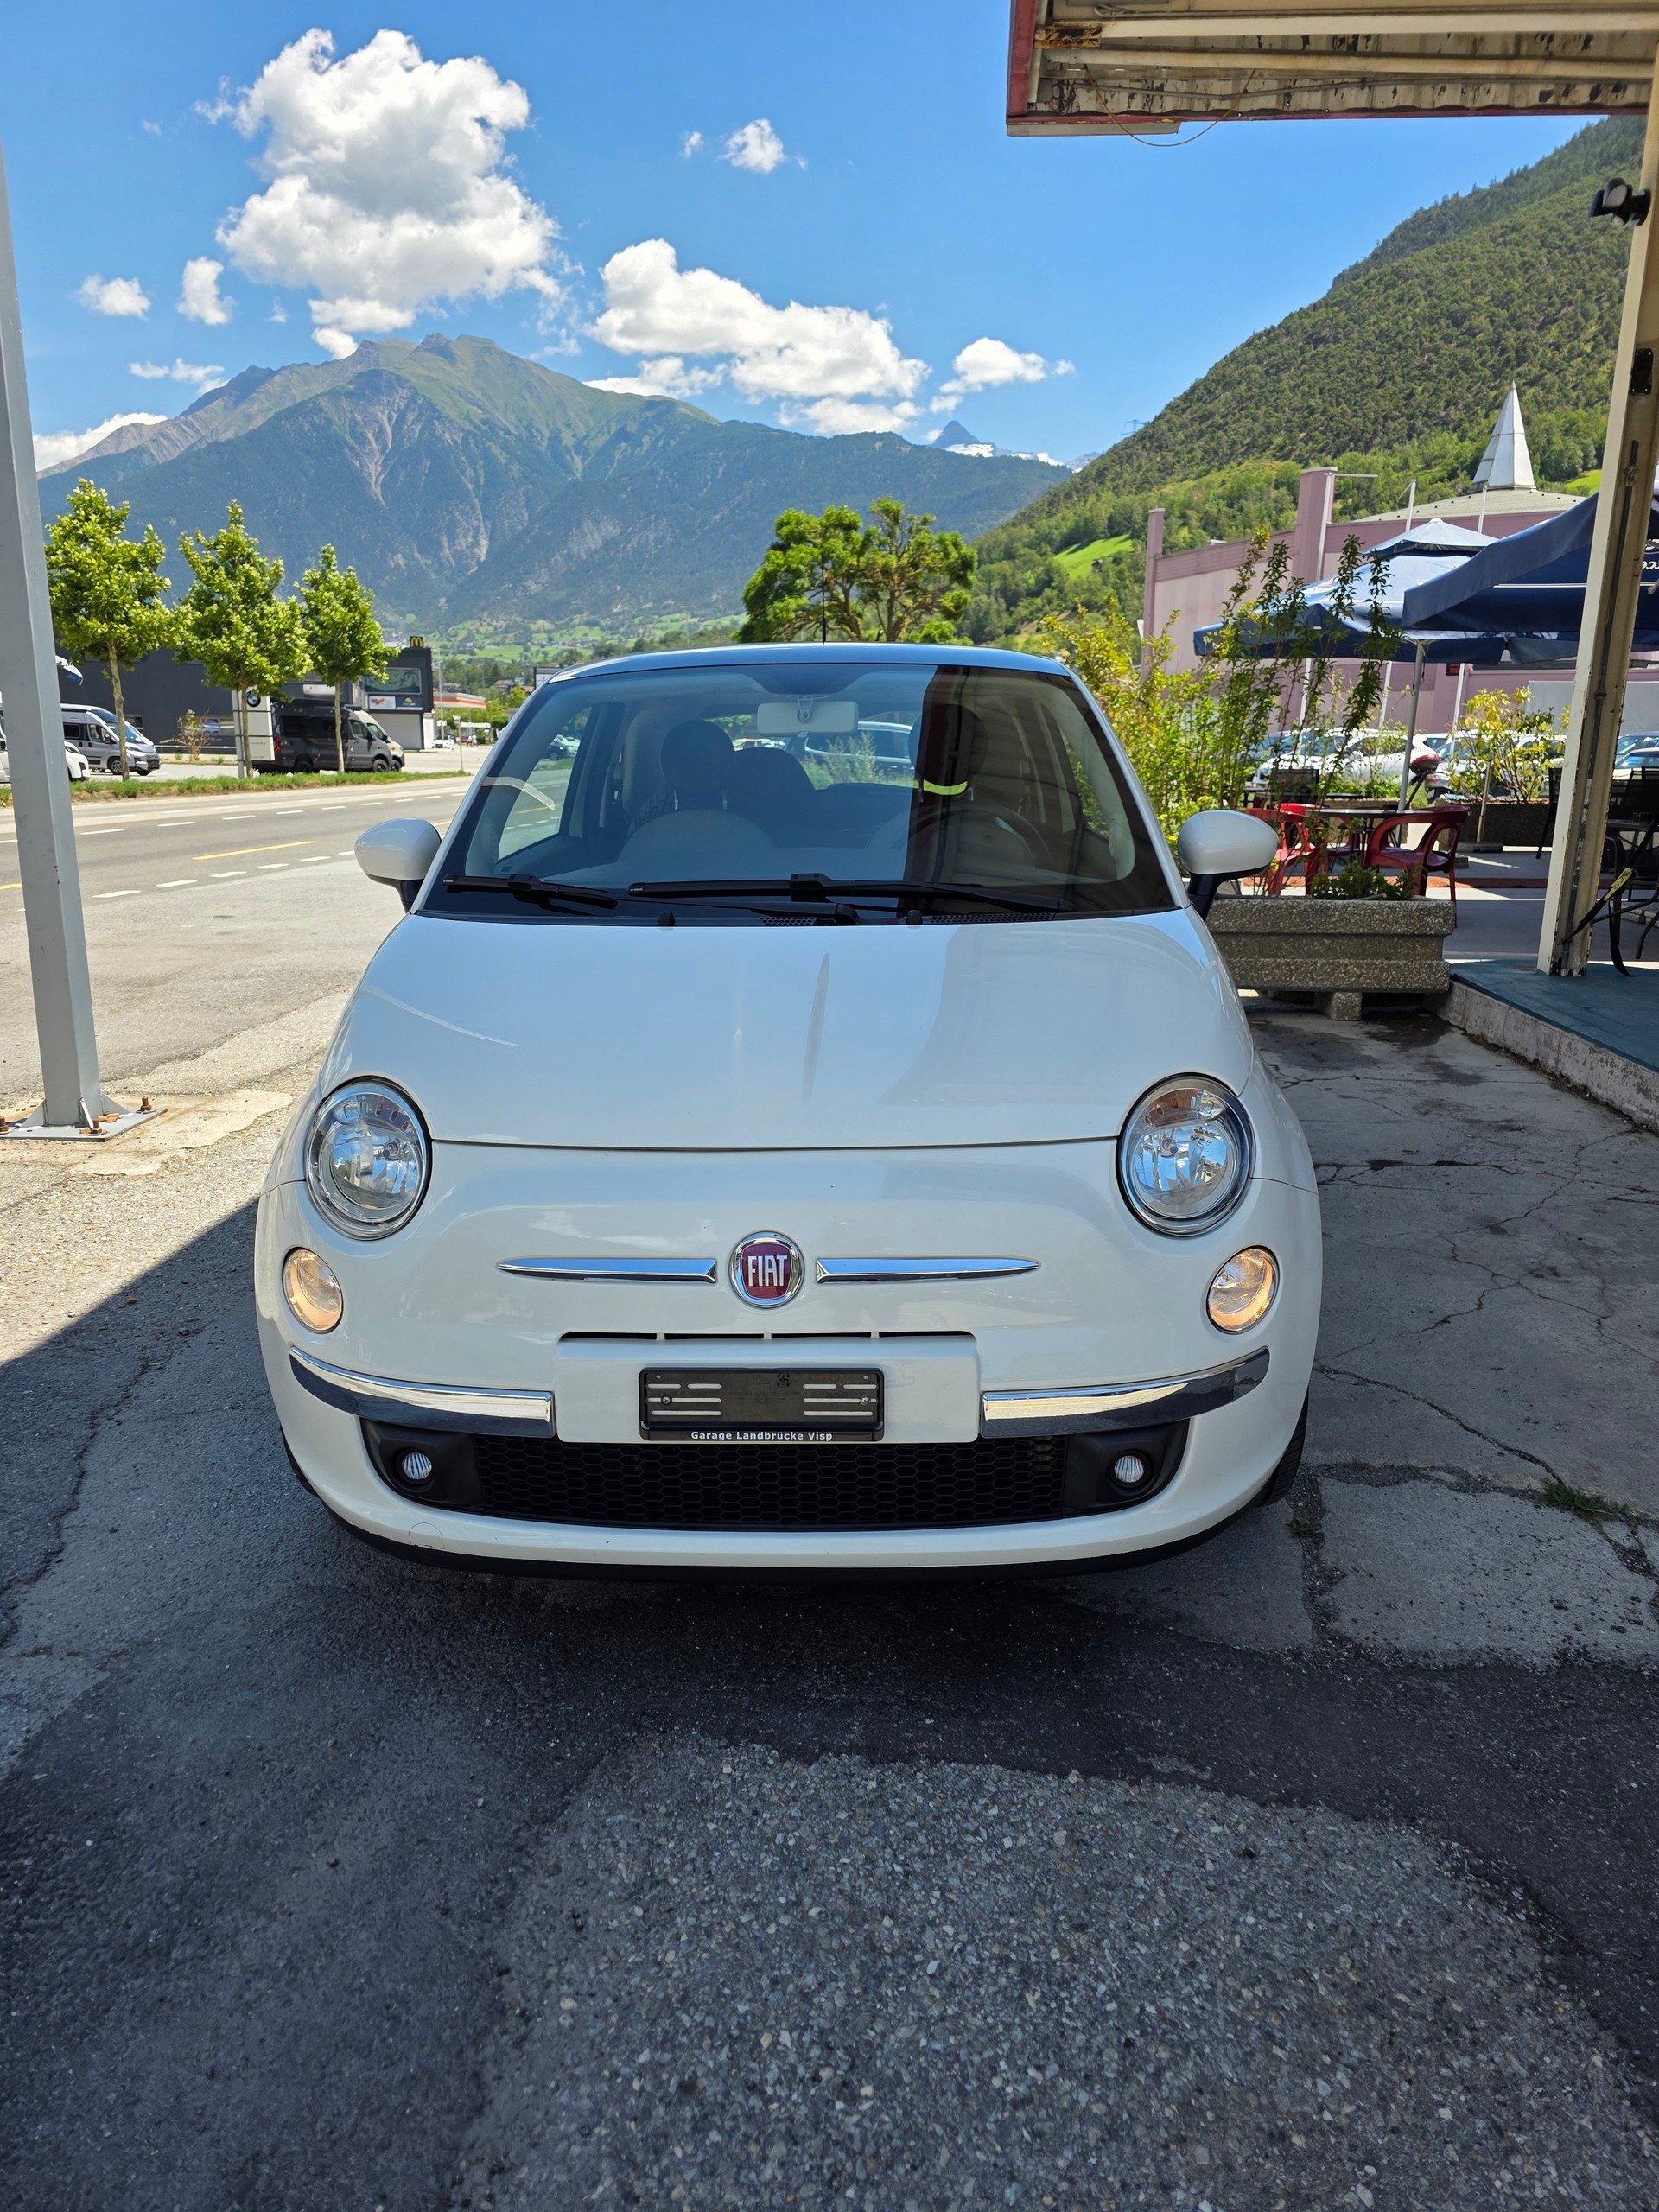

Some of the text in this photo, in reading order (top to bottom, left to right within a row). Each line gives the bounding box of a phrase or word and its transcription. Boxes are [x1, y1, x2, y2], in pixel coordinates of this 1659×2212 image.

[747, 1255, 788, 1287] FIAT
[690, 1431, 833, 1441] Garage Landbrücke Visp
